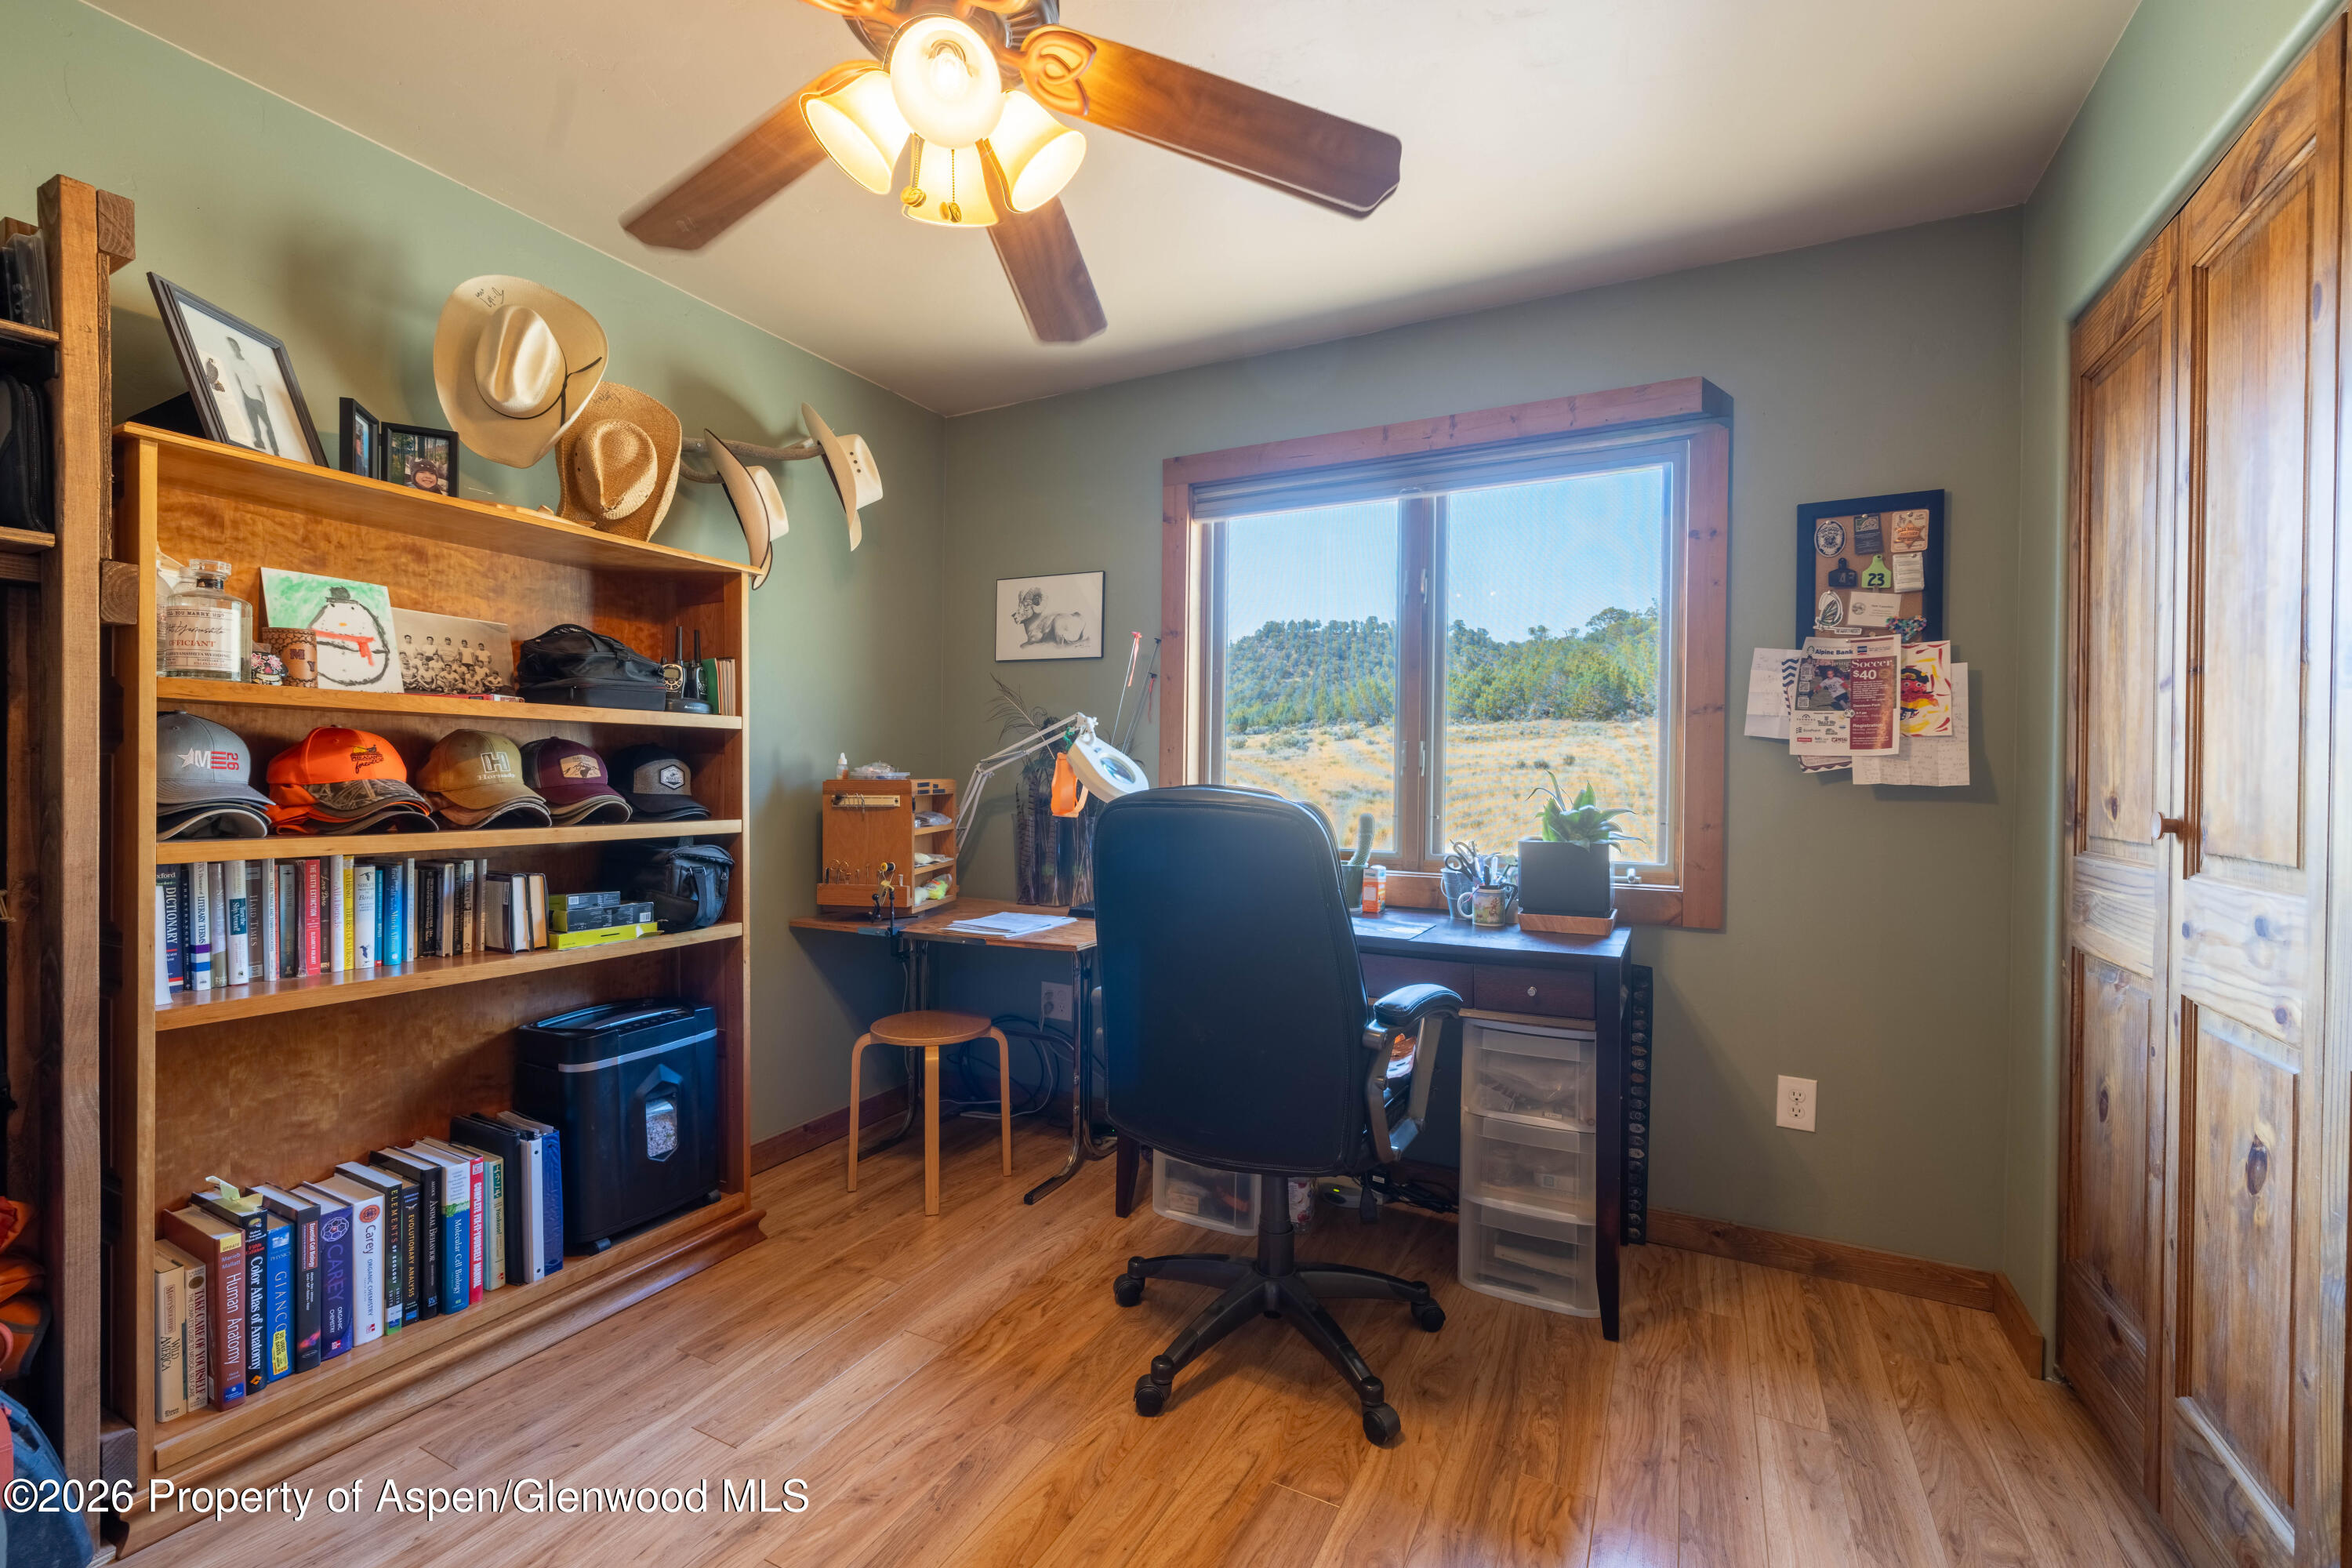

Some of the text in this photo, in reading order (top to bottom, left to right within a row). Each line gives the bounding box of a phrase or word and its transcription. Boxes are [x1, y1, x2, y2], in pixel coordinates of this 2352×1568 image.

[1867, 573, 1885, 586] 23
[290, 649, 305, 659] M
[1851, 659, 1893, 668] Soccer
[307, 661, 315, 672] Y
[1853, 670, 1877, 680] $40
[227, 753, 239, 771] 26
[477, 772, 515, 781] Hornady
[321, 875, 329, 891] Love
[321, 891, 329, 906] Dare
[165, 887, 177, 944] DICTIONARY
[363, 1225, 376, 1254] Carey
[429, 1200, 438, 1262] ANIMAL BEHAVIOR
[223, 1242, 240, 1250] UPDATE
[222, 1253, 241, 1262] Marieb
[222, 1259, 241, 1270] Mallatt
[327, 1243, 344, 1301] CAREY
[453, 1268, 462, 1294] Biology
[473, 1263, 481, 1288] MANUAL
[165, 1286, 174, 1305] MARTY
[195, 1289, 205, 1312] TAKE
[274, 1270, 287, 1333] GIANCO
[224, 1272, 242, 1366] Human Anatomy
[248, 1256, 263, 1370] Color Atlas of Anatomy
[195, 1312, 206, 1338] CARE
[171, 1338, 180, 1359] WILD
[195, 1338, 205, 1348] OF
[160, 1336, 172, 1372] AMERICA
[196, 1349, 206, 1394] YOURSELF
